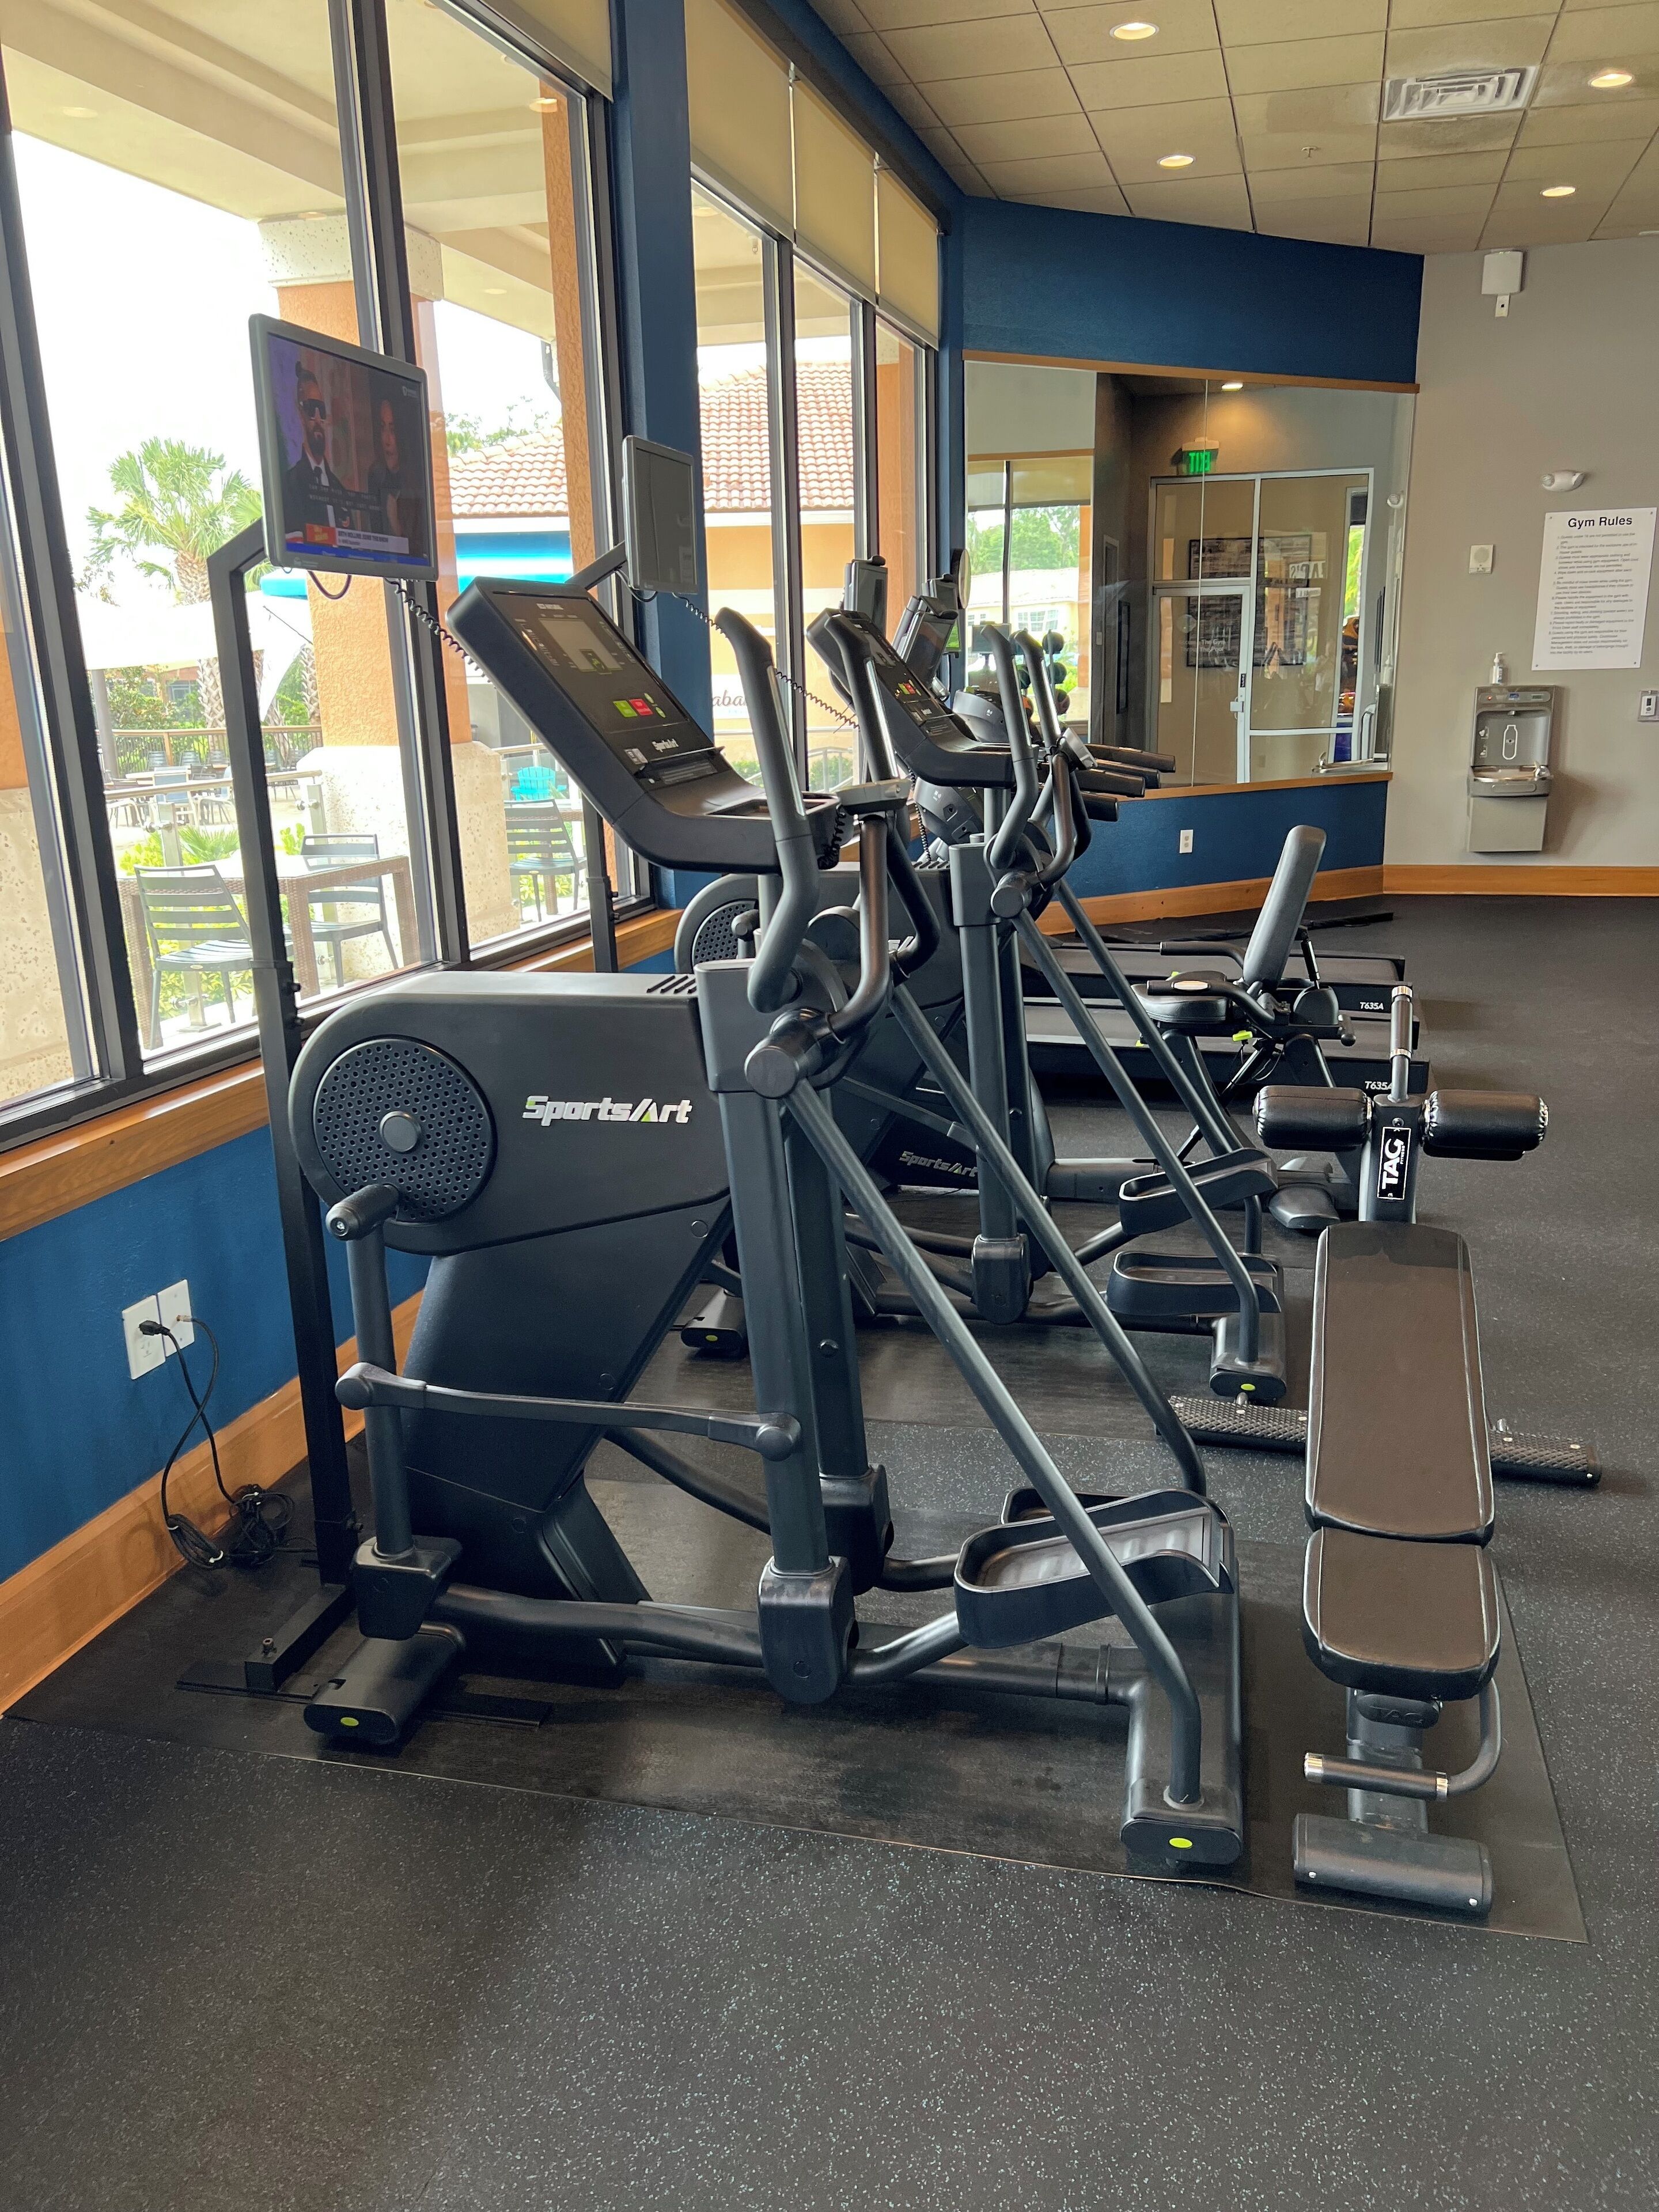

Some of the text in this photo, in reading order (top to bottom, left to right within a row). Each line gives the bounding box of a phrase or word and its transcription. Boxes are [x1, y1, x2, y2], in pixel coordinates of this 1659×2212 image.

[1568, 516, 1633, 529] Gym Rules
[1360, 1002, 1384, 1010] T635A
[522, 1096, 692, 1126] SportsArt
[899, 1151, 978, 1177] SportsArt
[1381, 1138, 1404, 1190] TAG
